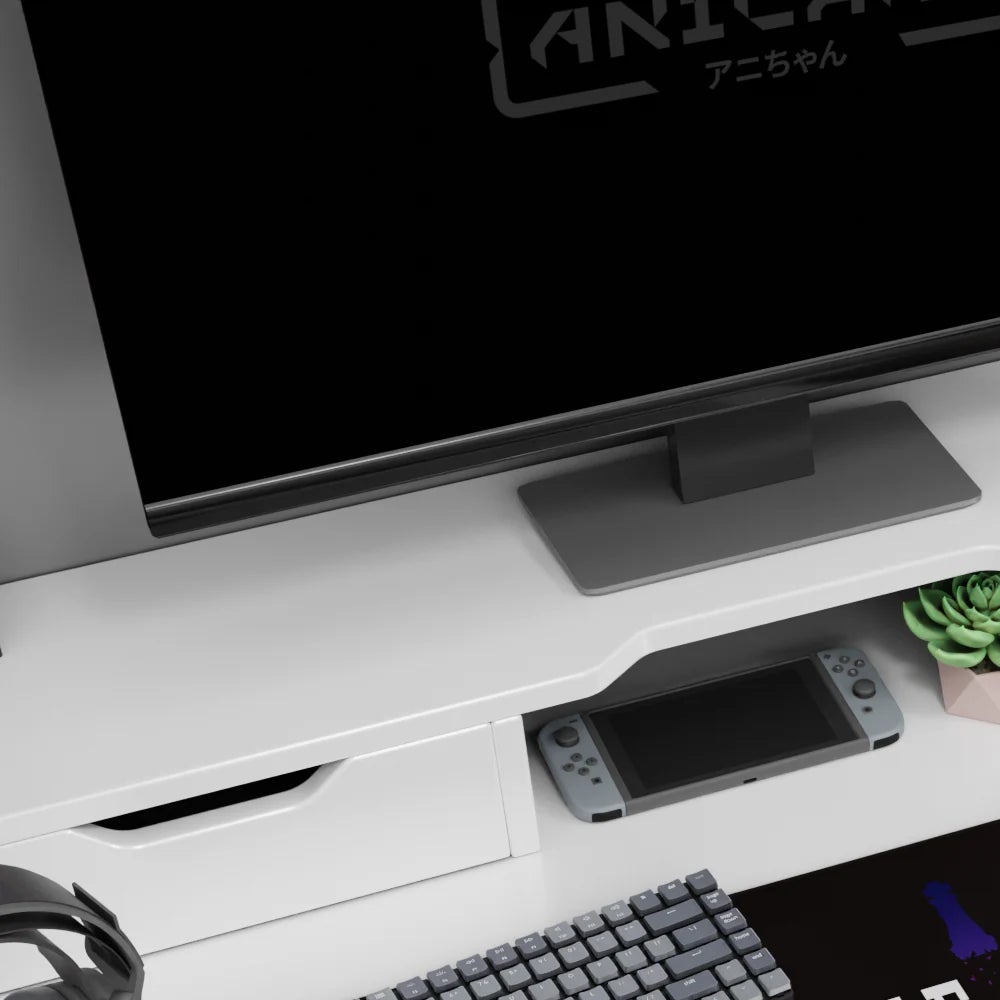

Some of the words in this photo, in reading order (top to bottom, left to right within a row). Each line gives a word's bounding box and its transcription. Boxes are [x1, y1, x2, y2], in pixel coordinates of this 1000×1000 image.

[705, 39, 848, 90] アニちゃん
